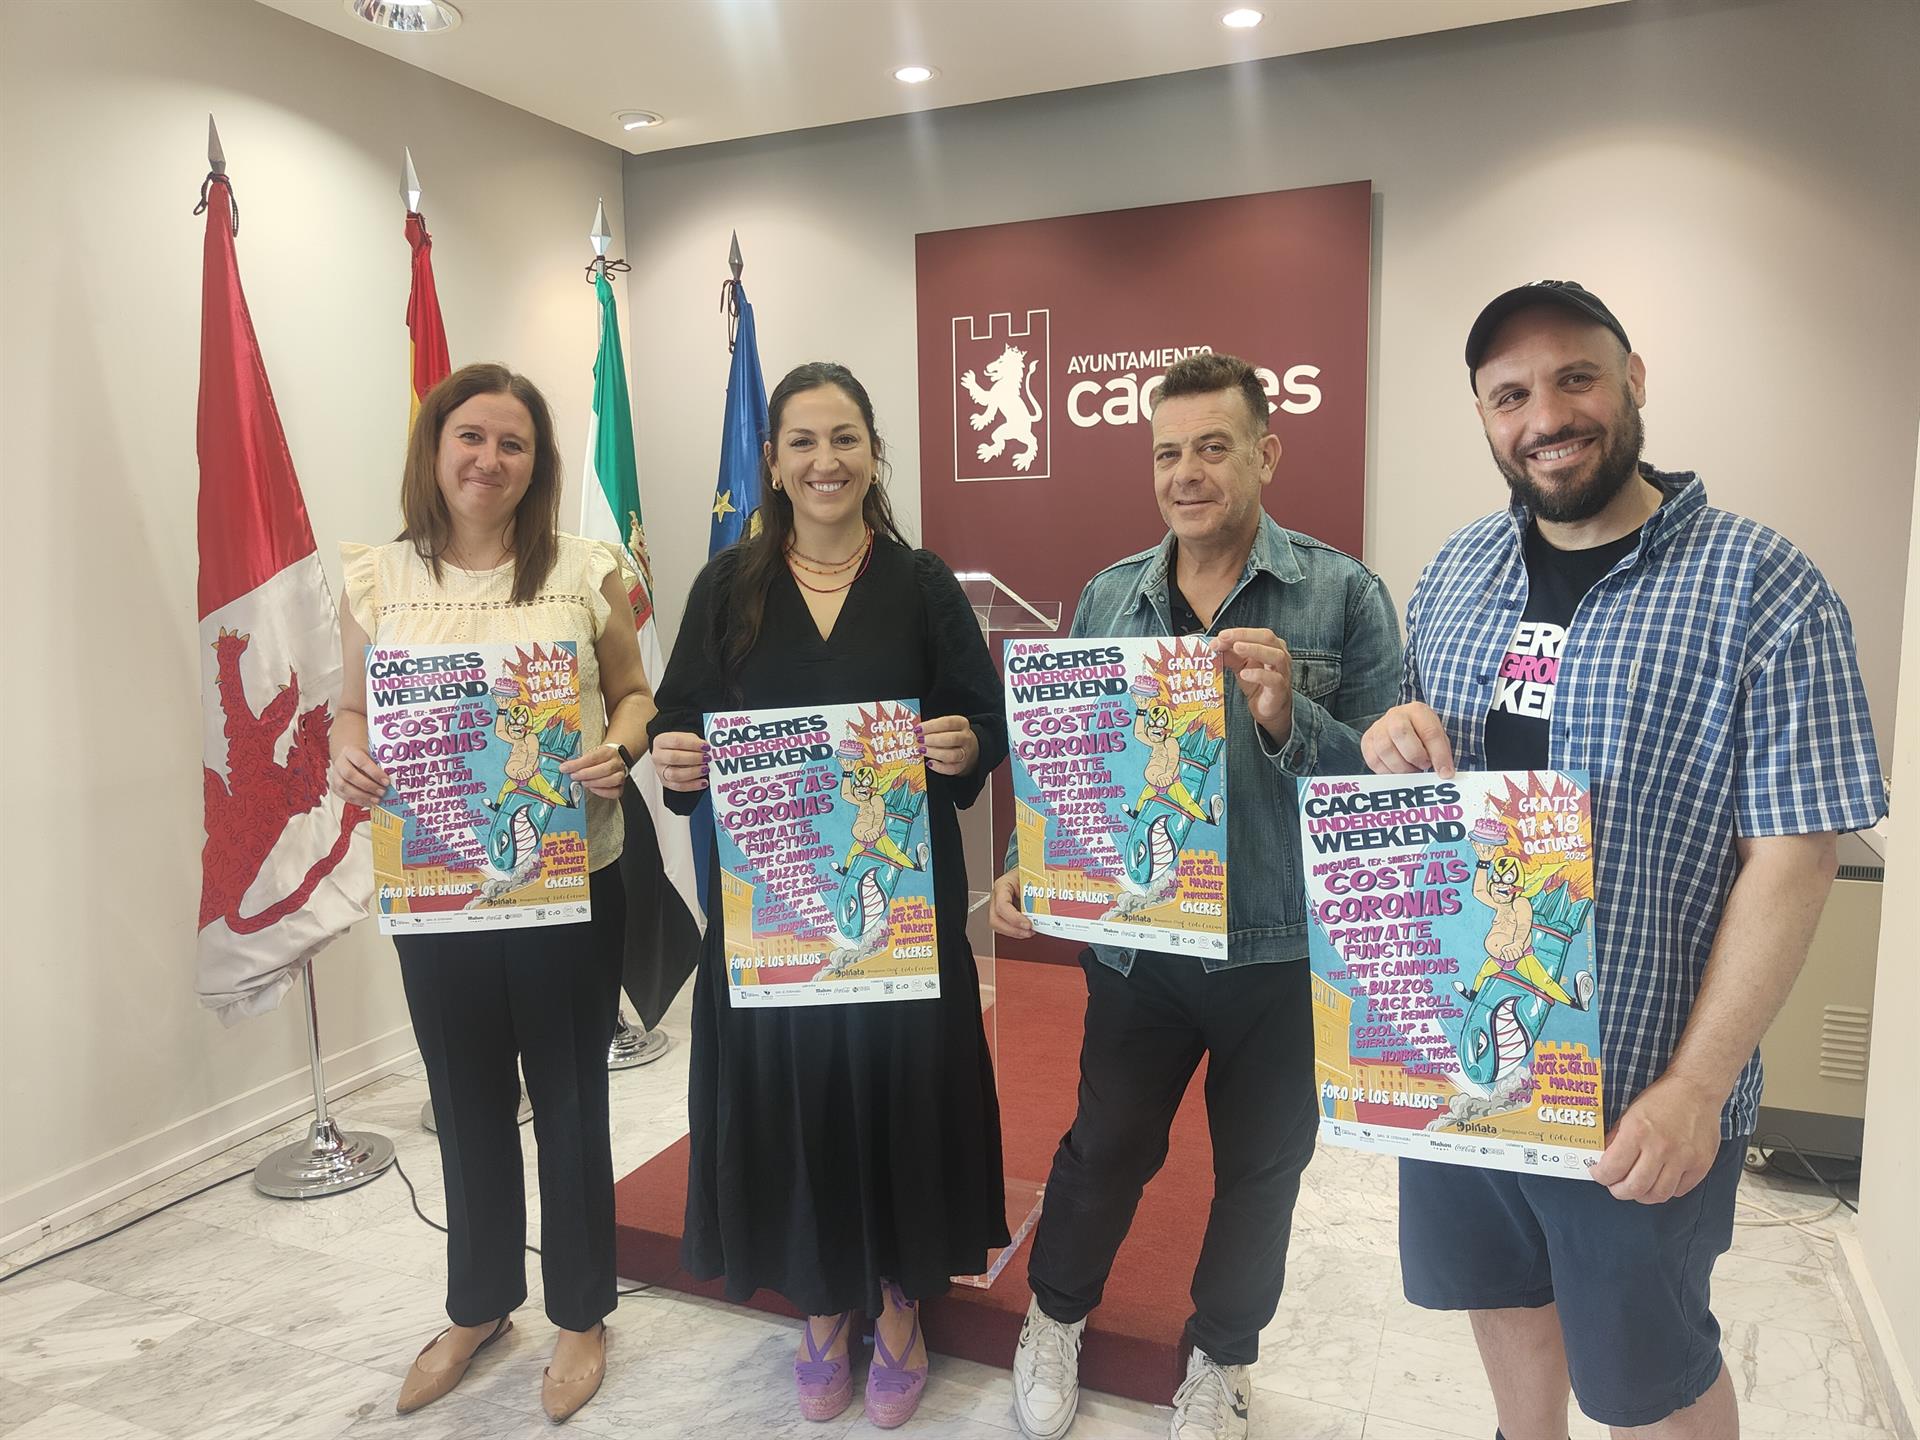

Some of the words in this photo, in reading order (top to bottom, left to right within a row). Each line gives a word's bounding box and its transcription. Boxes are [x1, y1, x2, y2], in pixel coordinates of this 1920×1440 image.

[374, 650, 388, 661] 10
[1013, 643, 1028, 656] 10
[371, 651, 484, 679] CACERES
[527, 659, 570, 673] GRATIS
[1009, 645, 1124, 674] CACERES
[1168, 656, 1214, 671] GRATIS
[372, 668, 487, 691] UNDERGROUND
[1010, 664, 1126, 687] UNDERGROUND
[373, 680, 489, 708] WEEKEND
[531, 686, 576, 703] OCTUBRE
[1012, 678, 1128, 704] WEEKEND
[1171, 687, 1220, 704] OCTUBRE
[381, 709, 493, 740] COSTAS
[709, 713, 828, 748] CACERES
[713, 716, 728, 729] 10
[870, 718, 914, 734] GRATIS
[1022, 708, 1132, 737] COSTAS
[377, 730, 488, 764] CORONAS
[712, 730, 831, 760] UNDERGROUND
[1018, 731, 1127, 760] CORONAS
[715, 743, 834, 776] WEEKEND
[1027, 756, 1105, 777] PRIVATE
[396, 768, 472, 791] FUNCTION
[1038, 770, 1111, 788] FUNCTION
[399, 790, 425, 805] FIVE
[426, 781, 487, 800] CANNONS
[727, 772, 839, 807] COSTAS
[1041, 789, 1066, 803] FIVE
[1066, 785, 1126, 801] CANNONS
[1310, 782, 1330, 798] 10
[416, 798, 467, 815] BUZZOS
[1057, 801, 1106, 815] BUZZOS
[1304, 782, 1461, 819] CACERES
[1518, 796, 1579, 813] GRATIS
[416, 813, 450, 828] RACK
[453, 808, 483, 821] ROLL
[724, 793, 834, 831] CORONAS
[1058, 816, 1090, 828] RACK
[1093, 814, 1122, 825] ROLL
[1307, 804, 1464, 834] UNDERGROUND
[406, 835, 439, 849] COOL
[440, 832, 455, 843] UP
[733, 819, 813, 846] PRIVATE
[1311, 821, 1467, 855] WEEKEND
[463, 845, 486, 859] TIGRE
[745, 831, 820, 857] FUNCTION
[1049, 838, 1079, 849] COOL
[1079, 837, 1094, 846] UP
[1523, 834, 1587, 855] OCTUBRE
[453, 857, 489, 870] RUFFOS
[552, 855, 585, 865] MARKET
[748, 855, 774, 871] FIVE
[775, 844, 834, 866] CANNONS
[1101, 854, 1123, 866] TIGRE
[1312, 856, 1365, 877] MIGUEL
[765, 862, 815, 881] BUZZOS
[1091, 867, 1126, 877] RUFFOS
[1174, 865, 1196, 877] ROCK
[1203, 865, 1225, 876] GRILL
[1324, 860, 1471, 895] COSTAS
[379, 888, 402, 900] FORO
[405, 887, 416, 897] DE
[418, 886, 437, 897] LOS
[437, 884, 473, 896] BALBOS
[766, 878, 799, 895] RACK
[802, 872, 831, 887] ROLL
[1189, 877, 1223, 891] MARKET
[1023, 885, 1044, 899] FORO
[1046, 888, 1056, 899] DE
[1058, 889, 1075, 901] LOS
[1076, 890, 1109, 904] BALBOS
[757, 902, 788, 917] COOL
[789, 898, 804, 909] UP
[1319, 888, 1462, 924] CORONAS
[812, 912, 834, 926] TIGRE
[900, 923, 933, 933] MARKET
[802, 924, 837, 939] RUFFOS
[1329, 920, 1432, 946] PRIVATE
[1343, 938, 1441, 961] FUNCTION
[730, 958, 752, 971] FORO
[755, 957, 765, 968] DE
[768, 955, 786, 968] LOS
[786, 953, 821, 967] BALBOS
[1347, 962, 1380, 979] FIVE
[1381, 958, 1459, 977] CANNONS
[1368, 978, 1433, 995] BUZZOS
[1368, 996, 1411, 1012] RACK
[1415, 994, 1454, 1008] ROLL
[1355, 1025, 1396, 1038] COOL
[1397, 1023, 1416, 1035] UP
[1381, 1050, 1424, 1063] HOMBRE
[1426, 1046, 1457, 1060] TIGRE
[1413, 1062, 1461, 1074] RUFFOS
[1528, 1061, 1558, 1075] ROCK
[1567, 1061, 1598, 1076] GRILL
[1549, 1076, 1597, 1094] MARKET
[1321, 1083, 1348, 1102] FORO
[1352, 1088, 1365, 1102] DE
[1368, 1089, 1391, 1105] LOS
[1392, 1091, 1438, 1110] BALBOS
